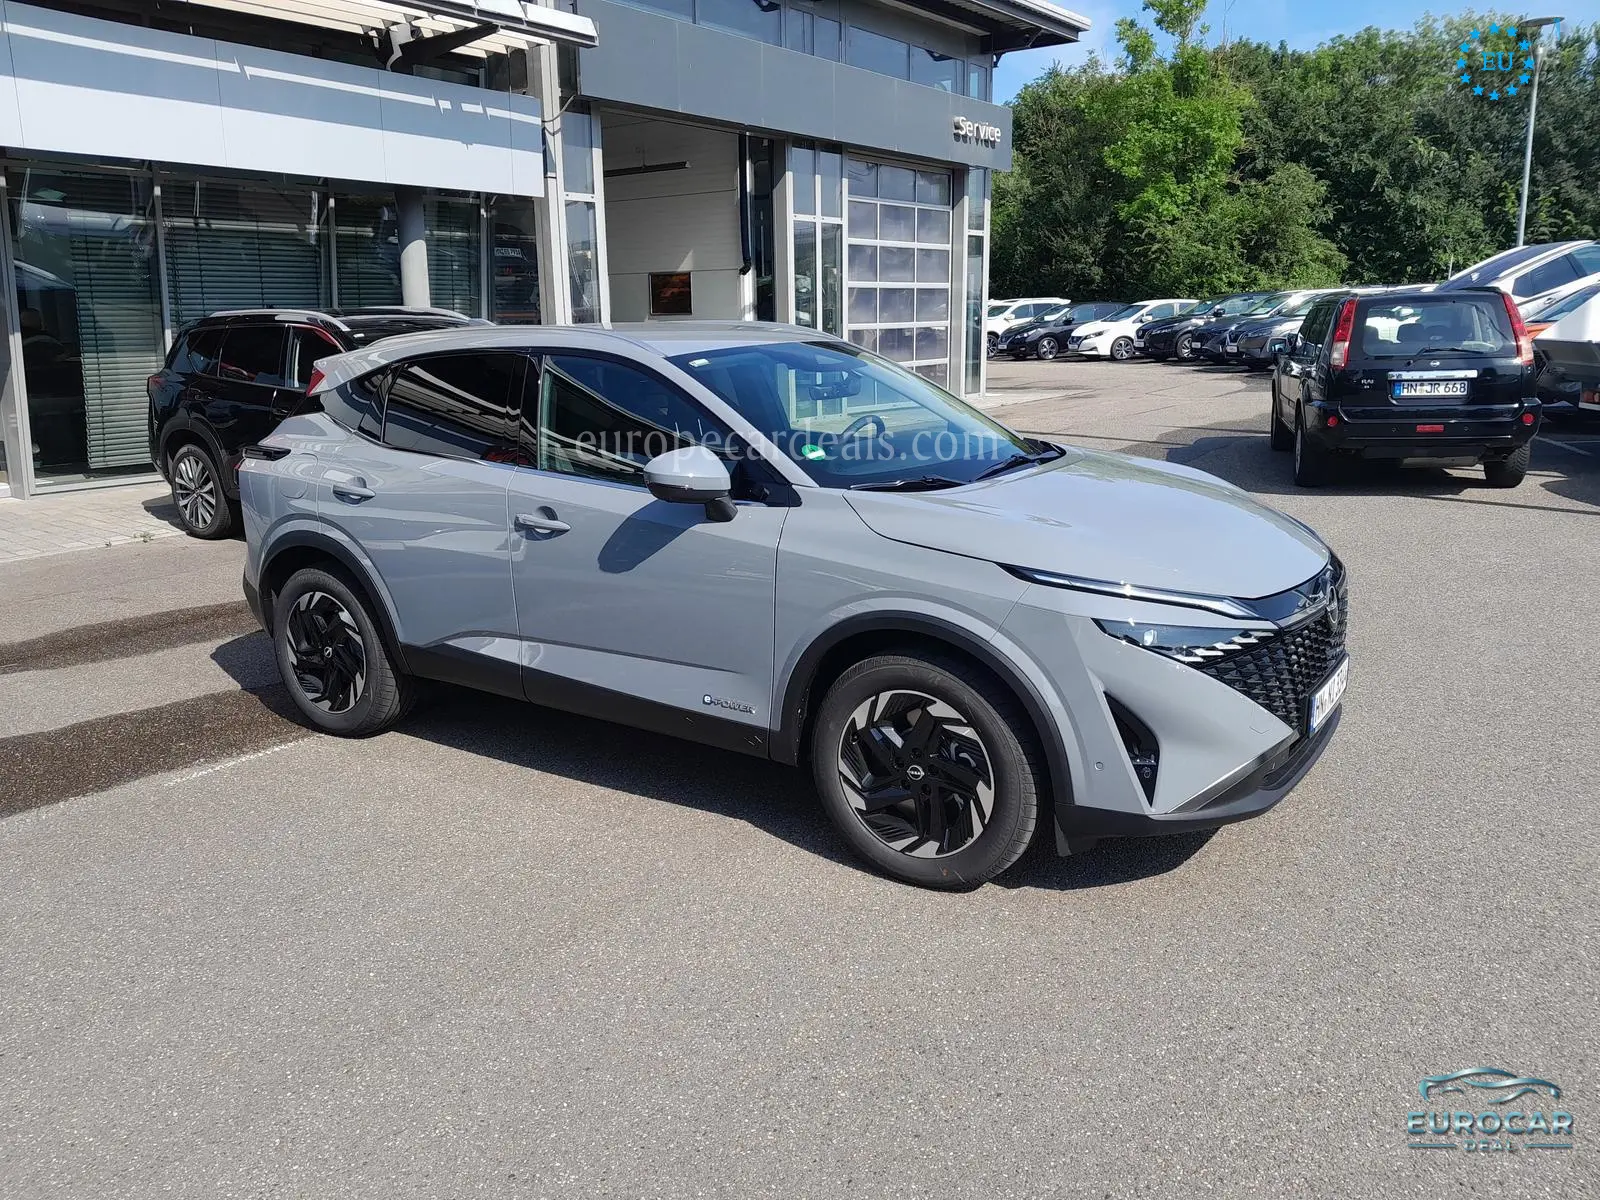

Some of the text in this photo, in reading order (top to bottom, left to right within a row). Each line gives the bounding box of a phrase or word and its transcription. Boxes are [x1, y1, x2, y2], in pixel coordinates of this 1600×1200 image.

[957, 116, 1001, 142] Service
[1402, 383, 1467, 394] HN JR 668
